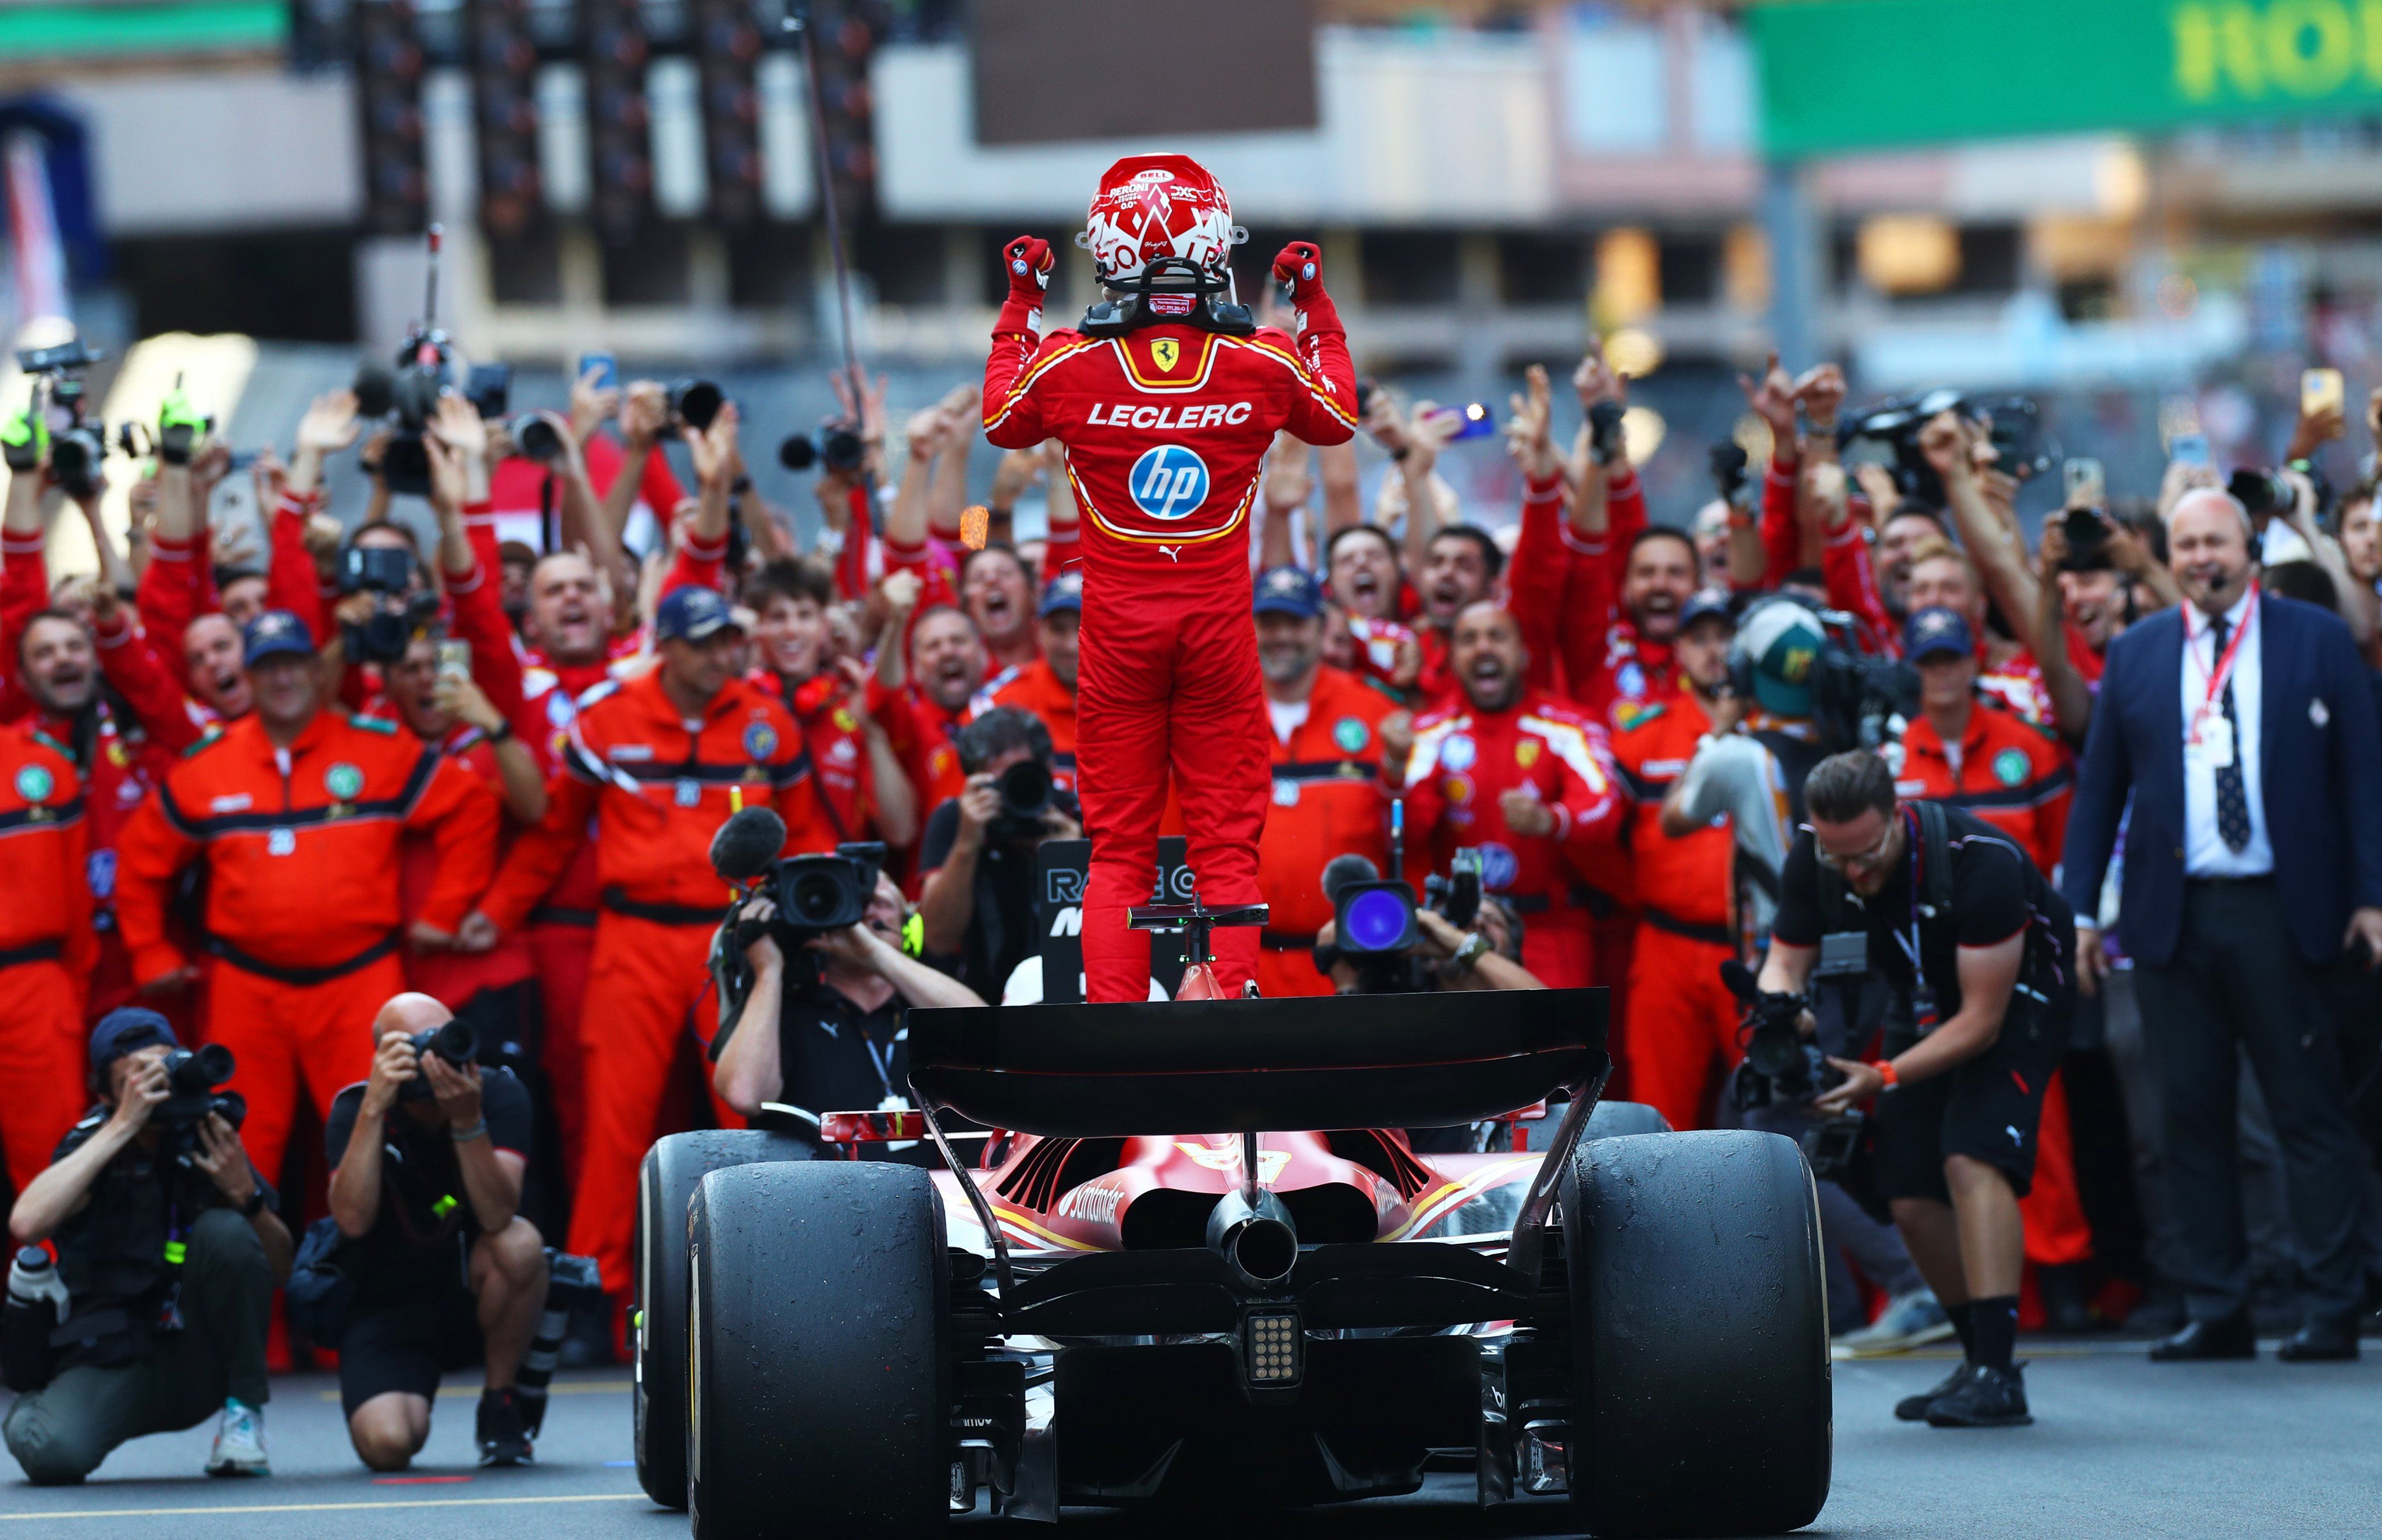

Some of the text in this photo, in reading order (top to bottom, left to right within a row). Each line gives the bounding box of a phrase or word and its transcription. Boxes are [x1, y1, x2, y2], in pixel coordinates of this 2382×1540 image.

[1110, 183, 1149, 198] PERONI
[1170, 186, 1197, 199] DXC
[1086, 402, 1252, 429] LECLERC
[1140, 447, 1200, 516] hp
[1069, 1179, 1125, 1224] Santander
